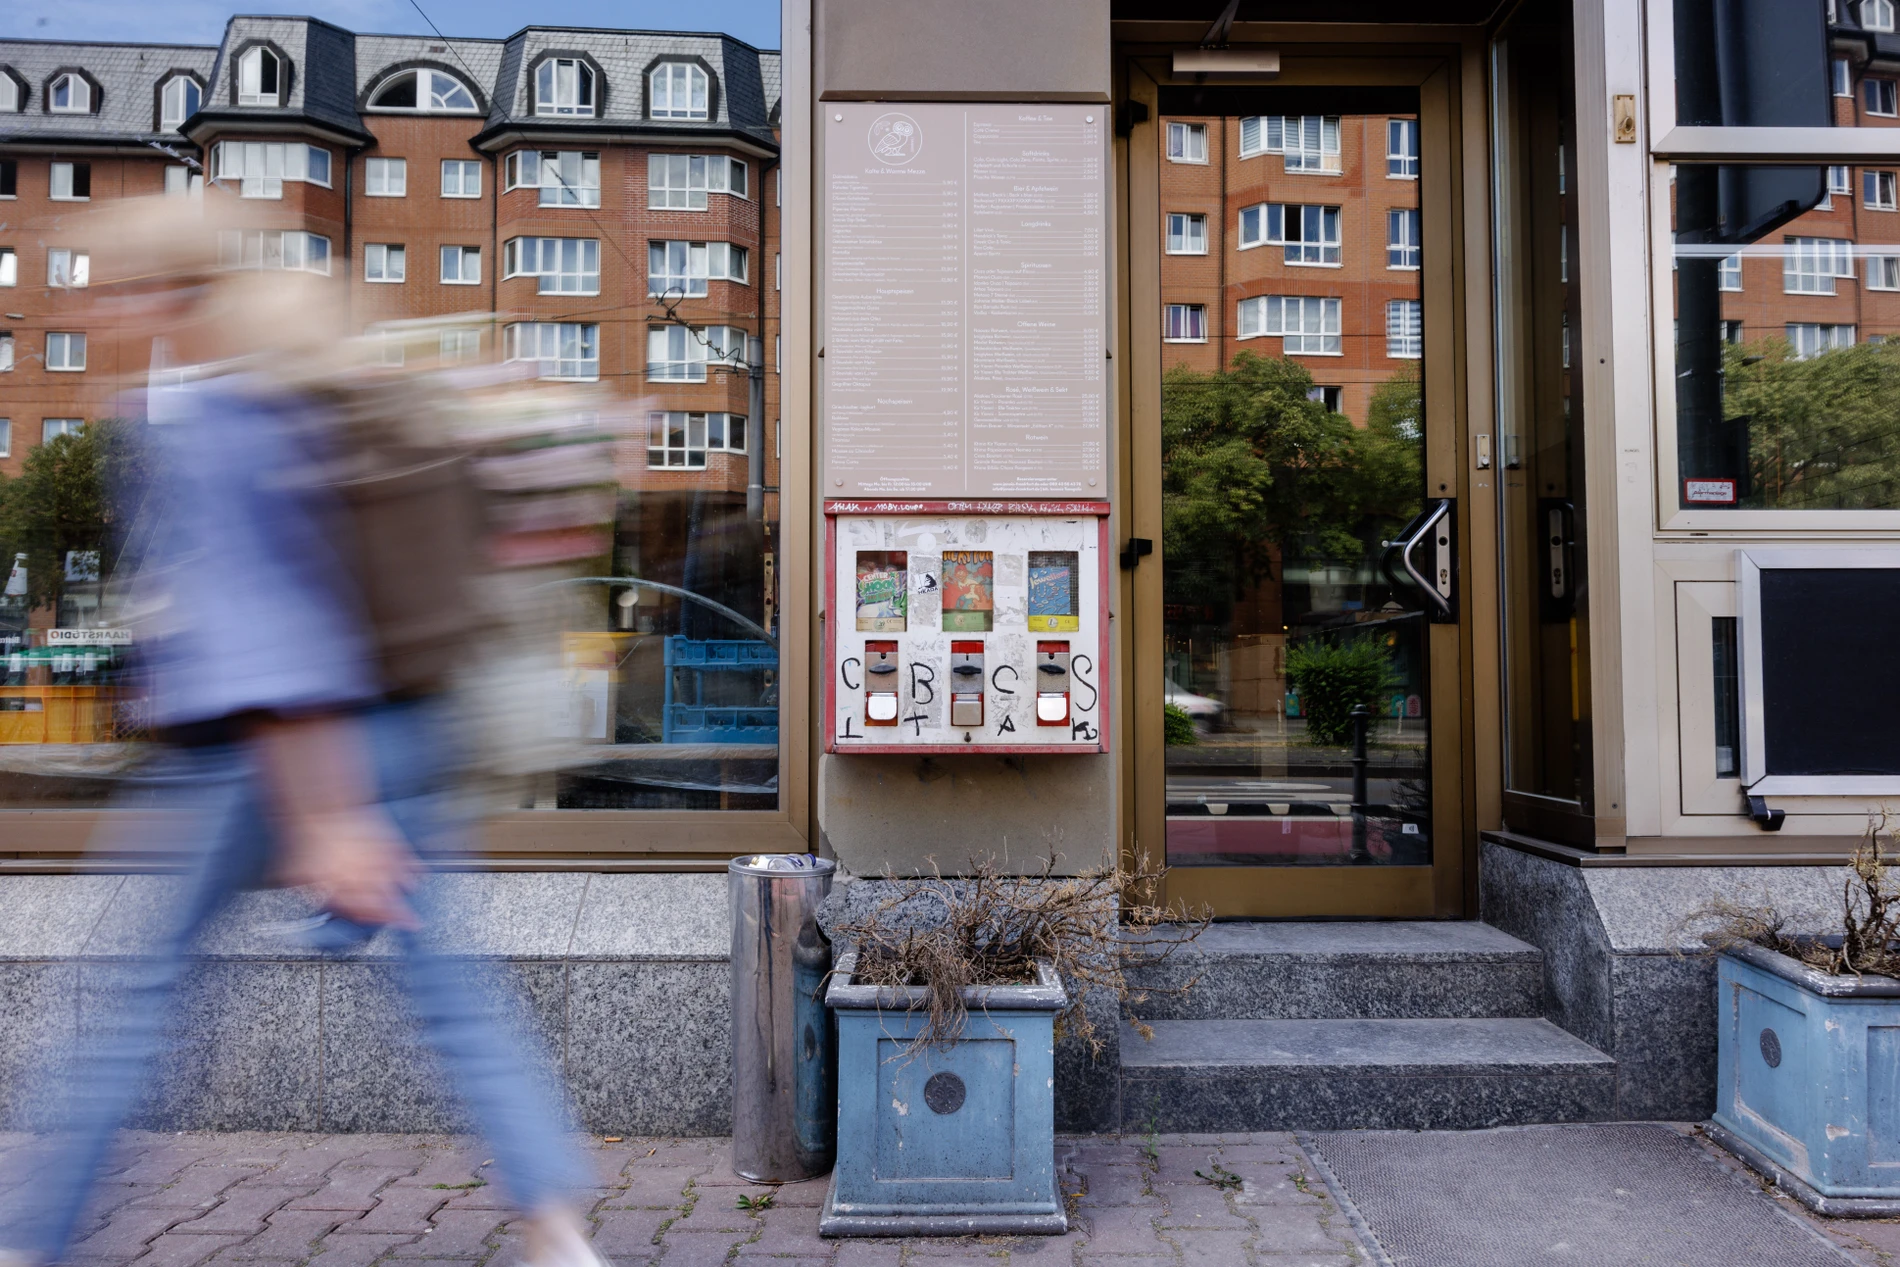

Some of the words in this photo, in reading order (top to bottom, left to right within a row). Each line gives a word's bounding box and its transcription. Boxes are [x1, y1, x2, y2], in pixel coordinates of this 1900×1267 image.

[864, 572, 888, 581] CENTER
[858, 578, 895, 596] SHOCK
[841, 658, 860, 689] C
[910, 662, 934, 705] B
[992, 665, 1018, 694] C
[1072, 654, 1097, 712] S
[998, 715, 1015, 736] A
